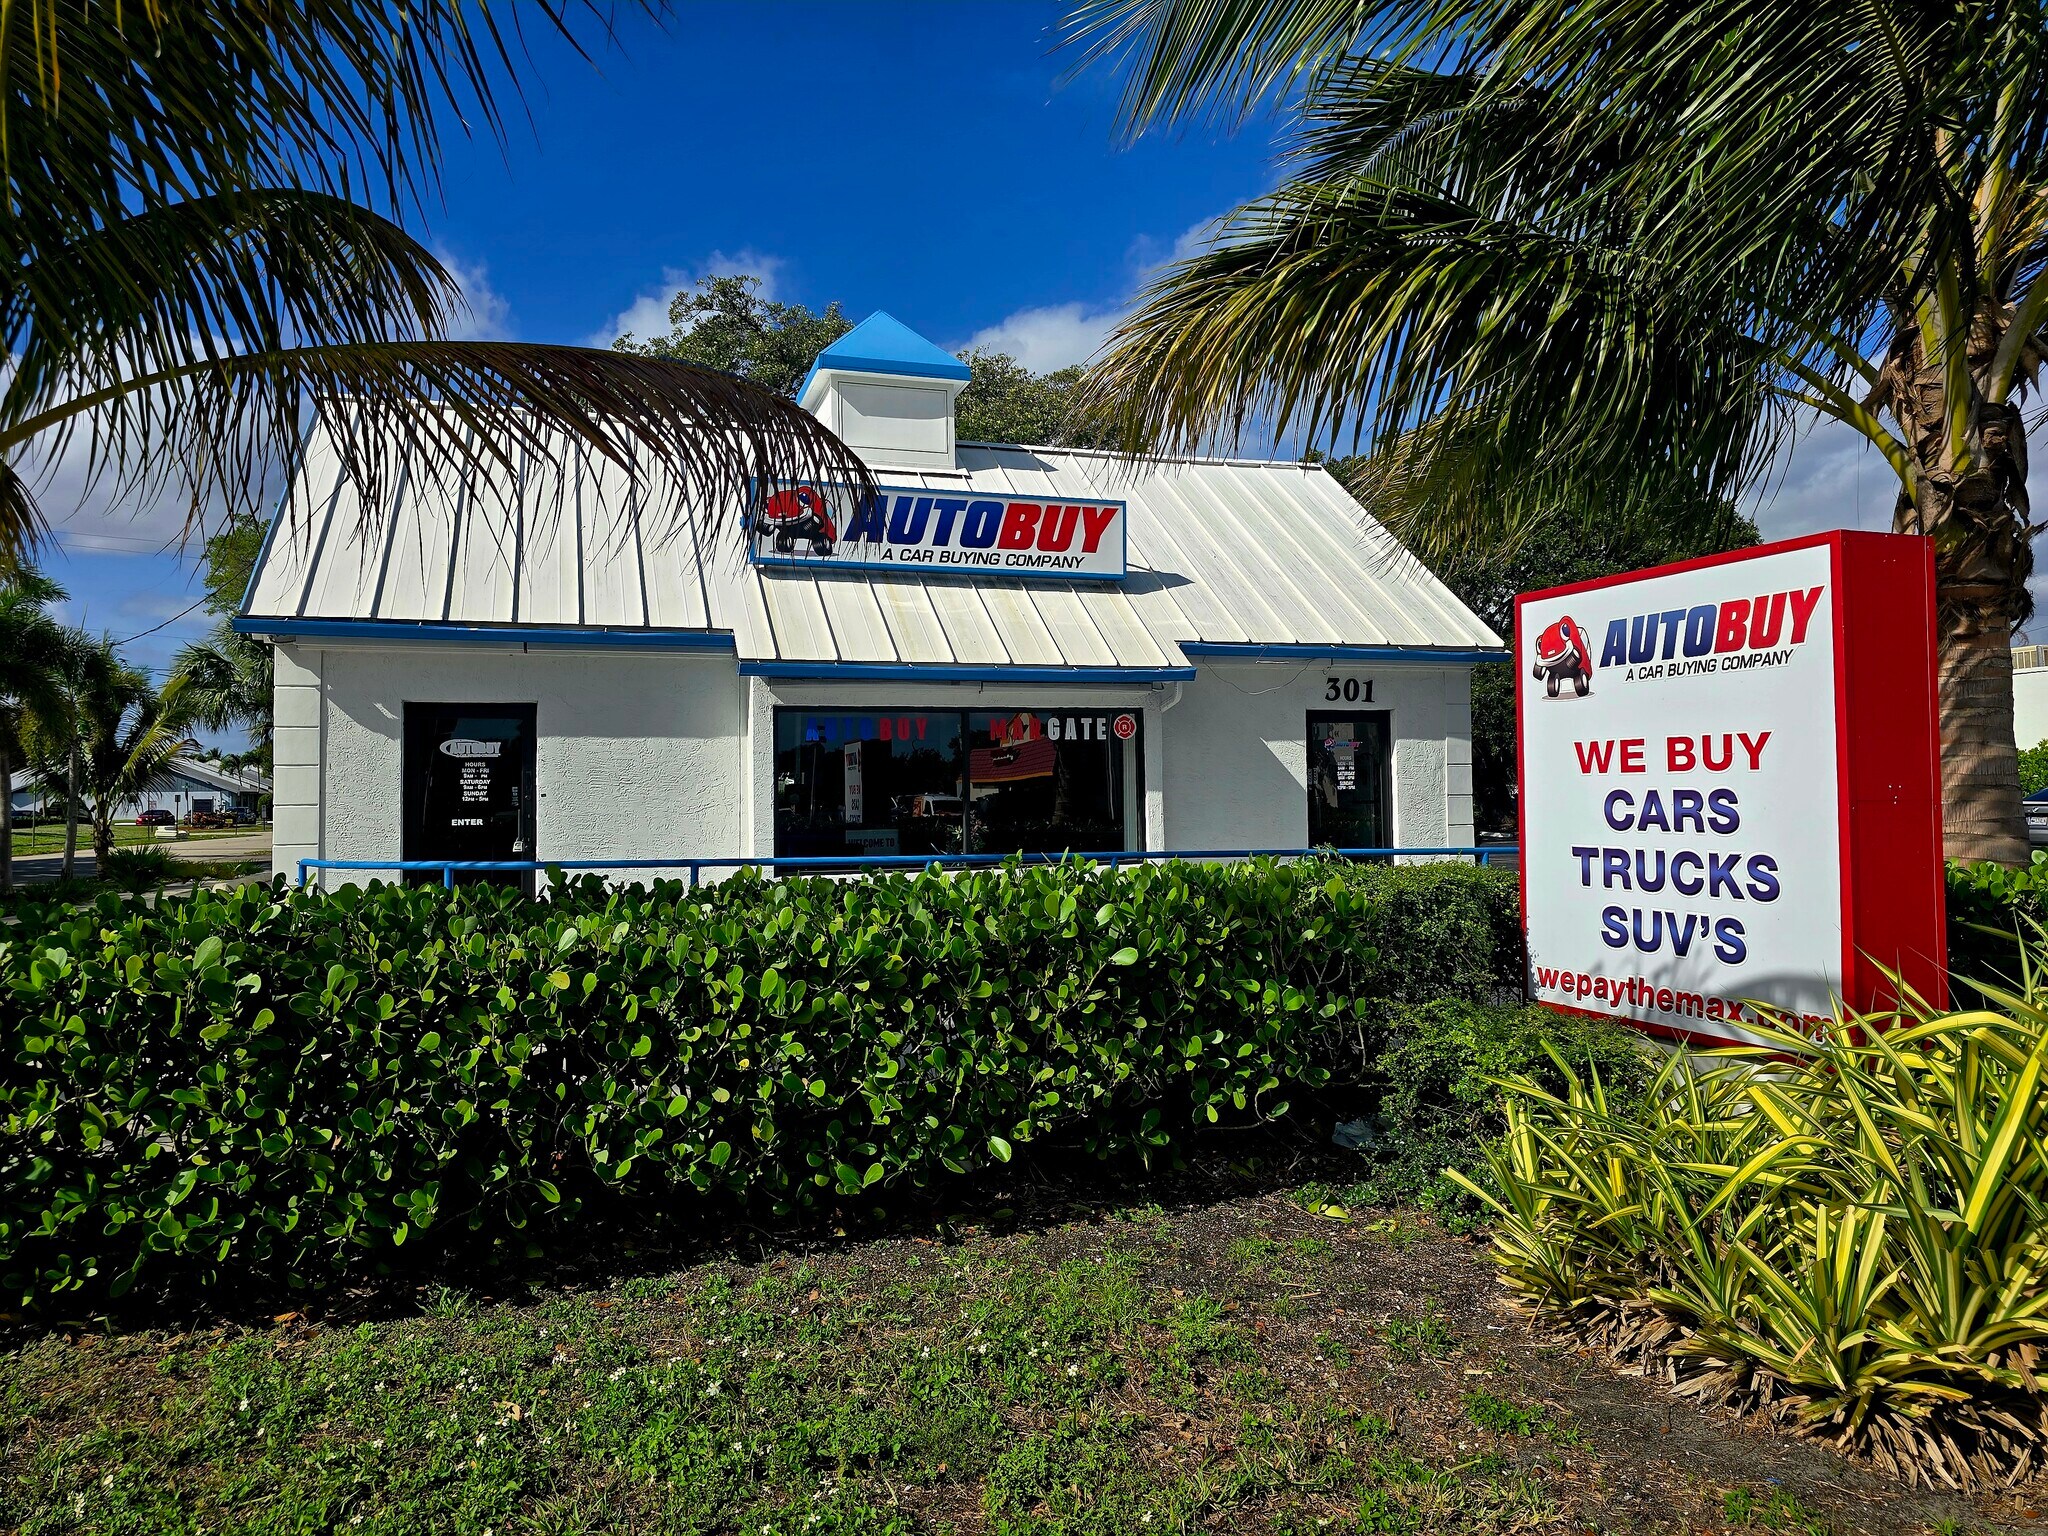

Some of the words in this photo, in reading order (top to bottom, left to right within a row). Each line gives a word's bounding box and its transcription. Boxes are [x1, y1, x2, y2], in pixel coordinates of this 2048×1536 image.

[842, 495, 1118, 553] AUTOBUY
[881, 548, 893, 561] A
[899, 548, 934, 563] CAR
[939, 550, 1000, 566] BUYING
[1005, 553, 1085, 569] COMPANY
[1599, 585, 1825, 668] AUTOBUY
[1625, 668, 1634, 682] A
[1638, 664, 1663, 680] CAR
[1667, 657, 1717, 677] BUYING
[1721, 648, 1794, 671] COMPANY
[1325, 677, 1375, 703] 301
[1574, 738, 1646, 774] WE
[1667, 731, 1771, 773] BUY
[1604, 789, 1740, 835] CARS
[886, 838, 895, 847] TO
[1572, 846, 1781, 902] TRUCKS
[1601, 906, 1747, 964] SUV'S
